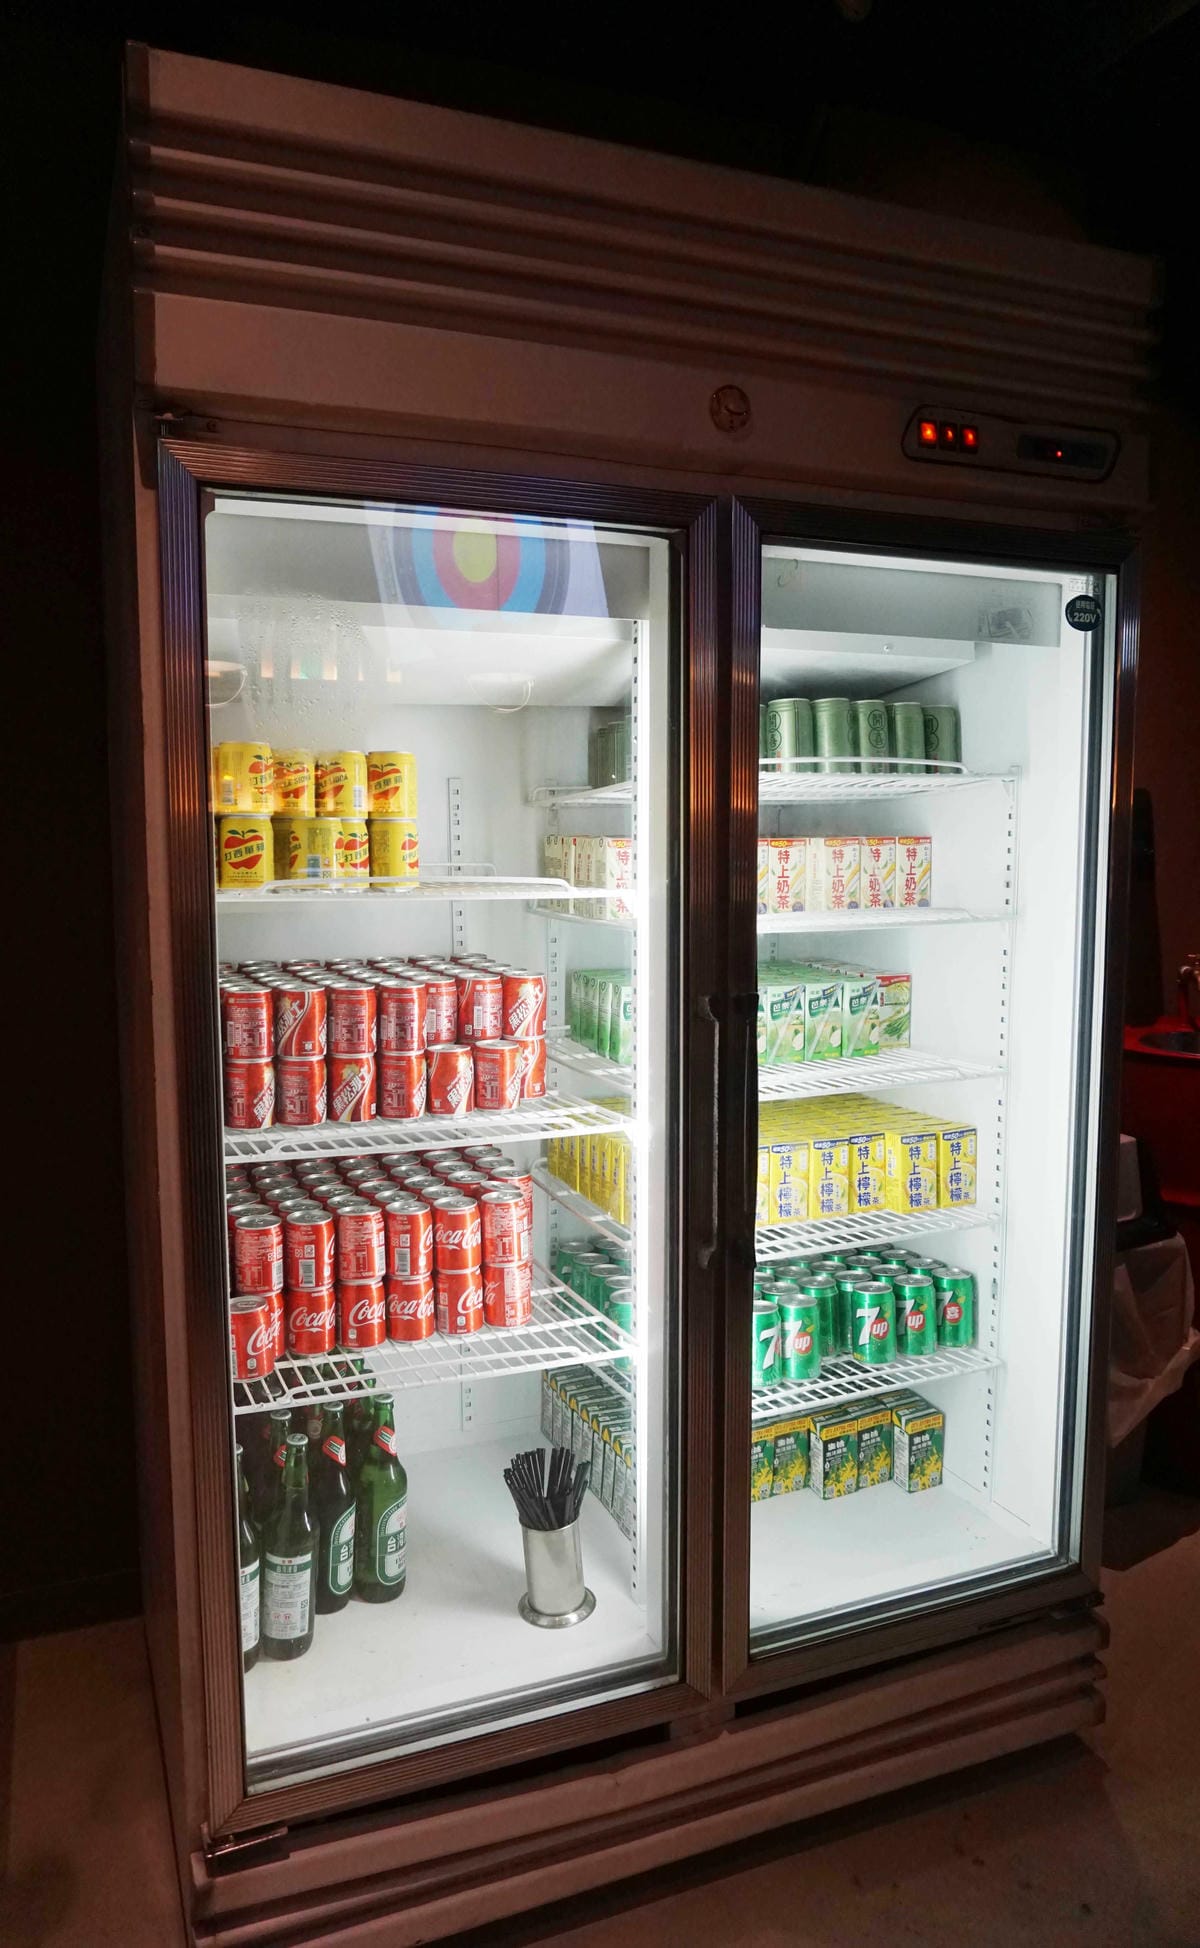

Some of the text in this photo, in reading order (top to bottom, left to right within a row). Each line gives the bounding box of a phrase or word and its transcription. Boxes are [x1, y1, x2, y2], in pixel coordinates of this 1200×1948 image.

[1073, 612, 1097, 624] 220V
[777, 849, 790, 909] 特上奶茶
[832, 848, 845, 908] 特上奶茶
[905, 847, 917, 906] 特上奶茶
[856, 1145, 871, 1207] 特上檸檬
[908, 1145, 922, 1208] 特上檸檬
[949, 1141, 962, 1202] 特上檸檬
